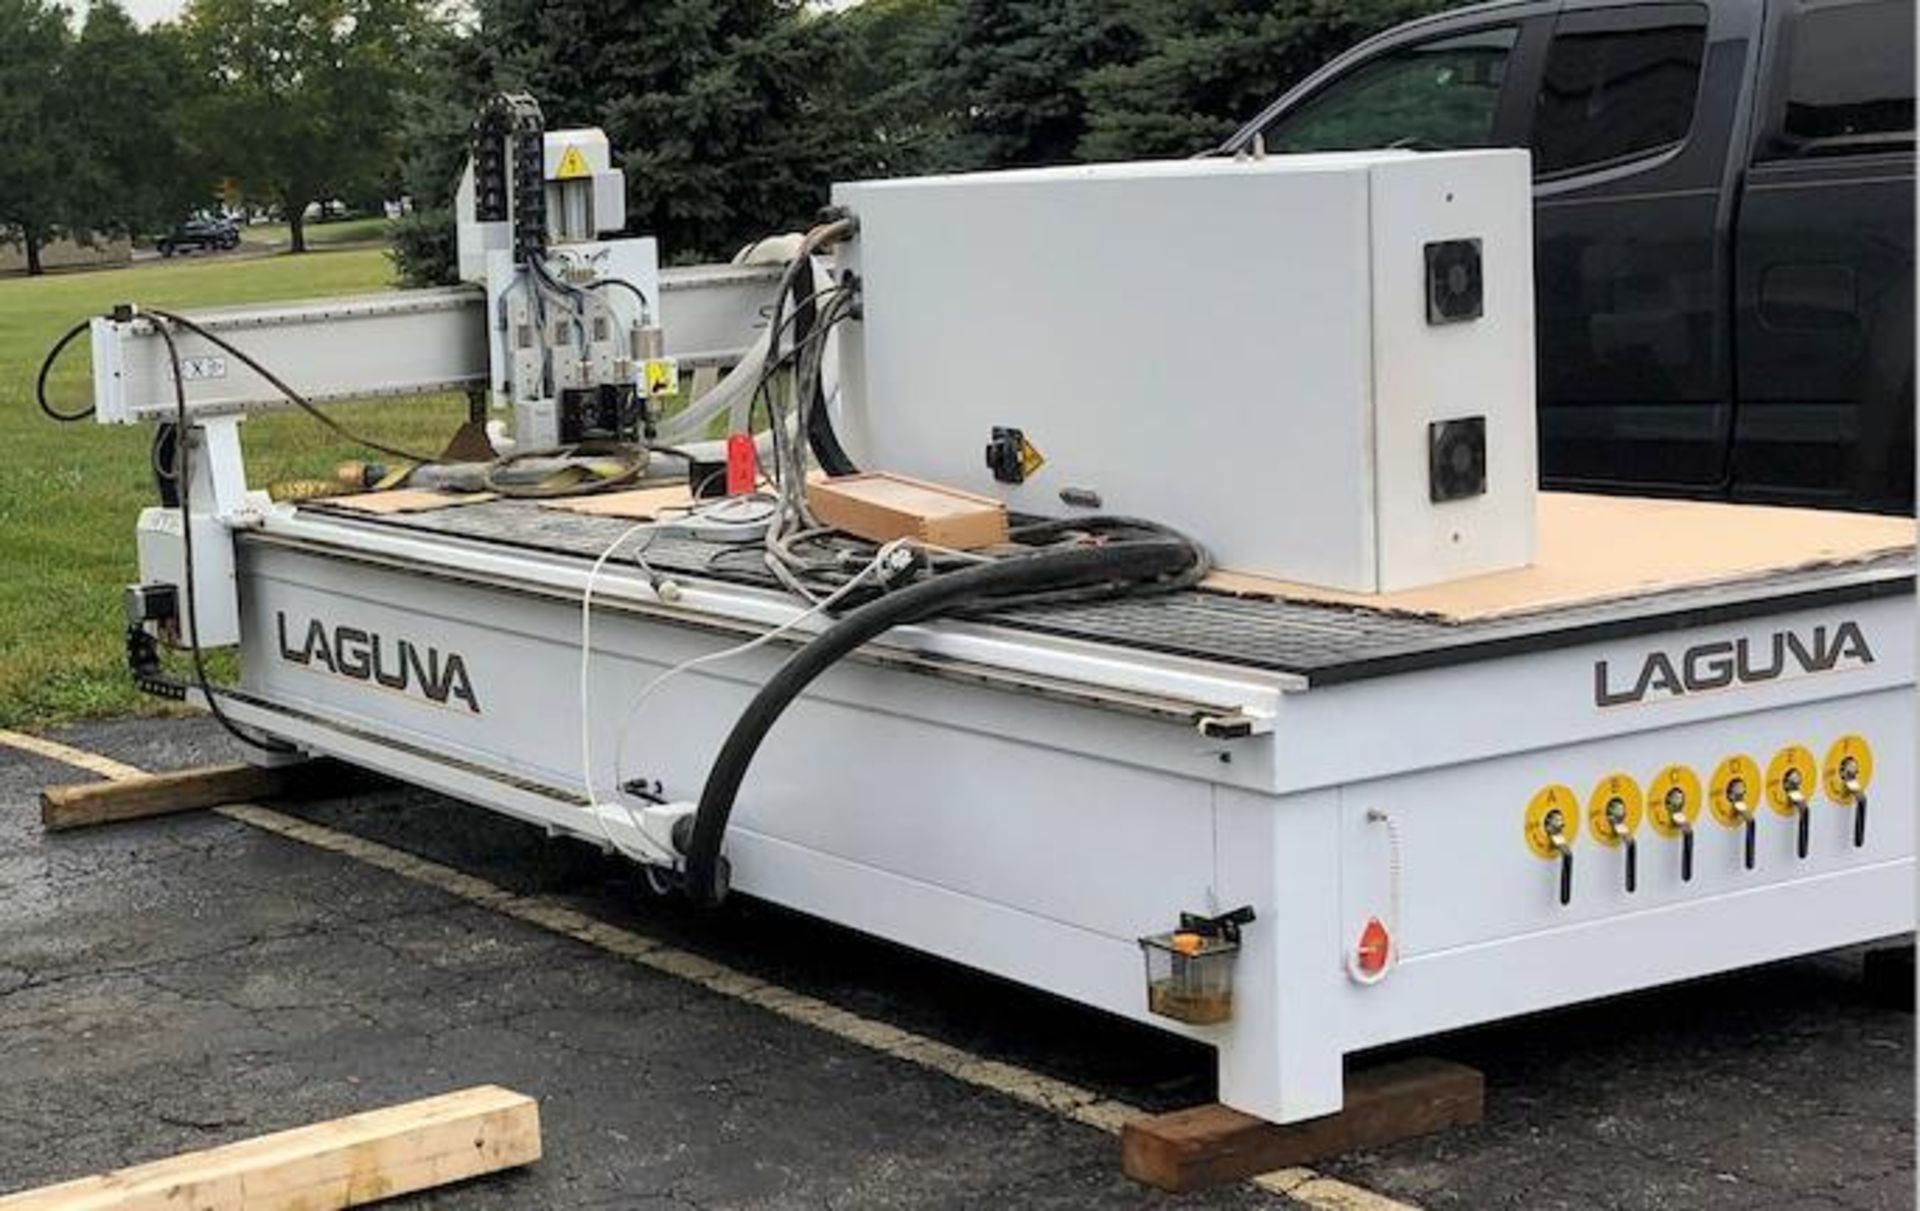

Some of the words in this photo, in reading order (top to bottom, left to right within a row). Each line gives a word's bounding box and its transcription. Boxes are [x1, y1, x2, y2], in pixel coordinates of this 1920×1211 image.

[277, 611, 481, 714] LAGUNA
[1594, 621, 1876, 708] LAGUNA
[1547, 789, 1557, 803] A
